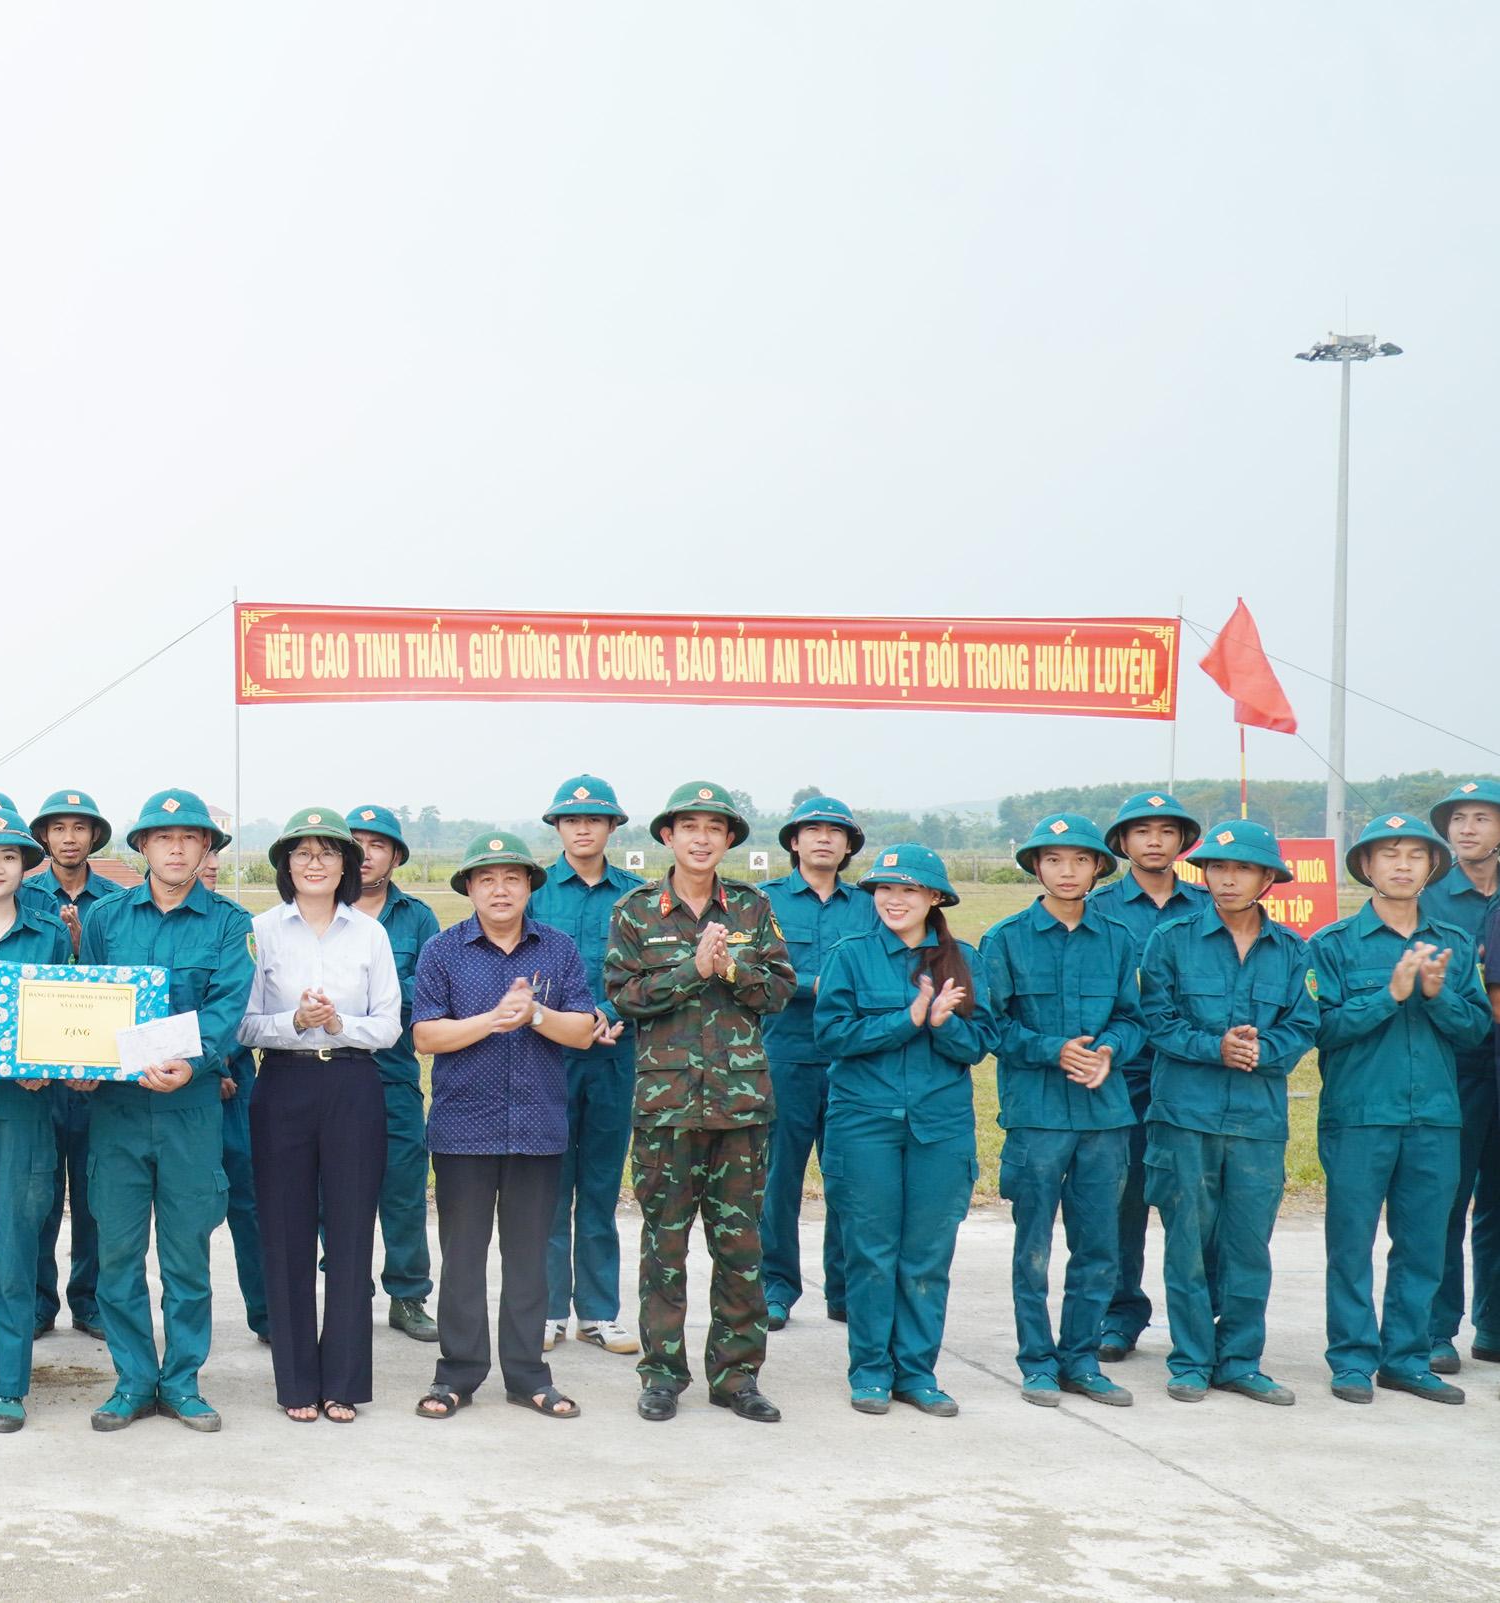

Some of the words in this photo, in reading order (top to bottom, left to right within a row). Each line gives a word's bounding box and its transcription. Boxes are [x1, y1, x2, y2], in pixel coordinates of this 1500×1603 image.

[265, 624, 304, 679] NÊU
[311, 632, 349, 678] CAO
[355, 632, 401, 678] TINH
[406, 616, 464, 684] THẦN,
[469, 624, 504, 679] GIỮ
[507, 624, 560, 679] VỮNG
[566, 619, 592, 679] KỶ
[597, 630, 671, 686] CƯƠNG,
[676, 621, 716, 682] BẢO
[720, 622, 766, 683] ĐẢM
[772, 637, 800, 683] AN
[804, 630, 858, 686] TOÀN
[862, 631, 920, 697] TUYỆT
[926, 626, 960, 688] ĐỐI
[964, 642, 1029, 691] TRONG
[1035, 629, 1089, 693] HUẤN
[1094, 638, 1156, 705] LUYỆN
[1297, 858, 1327, 882] MƯA
[1288, 895, 1313, 928] TẬP
